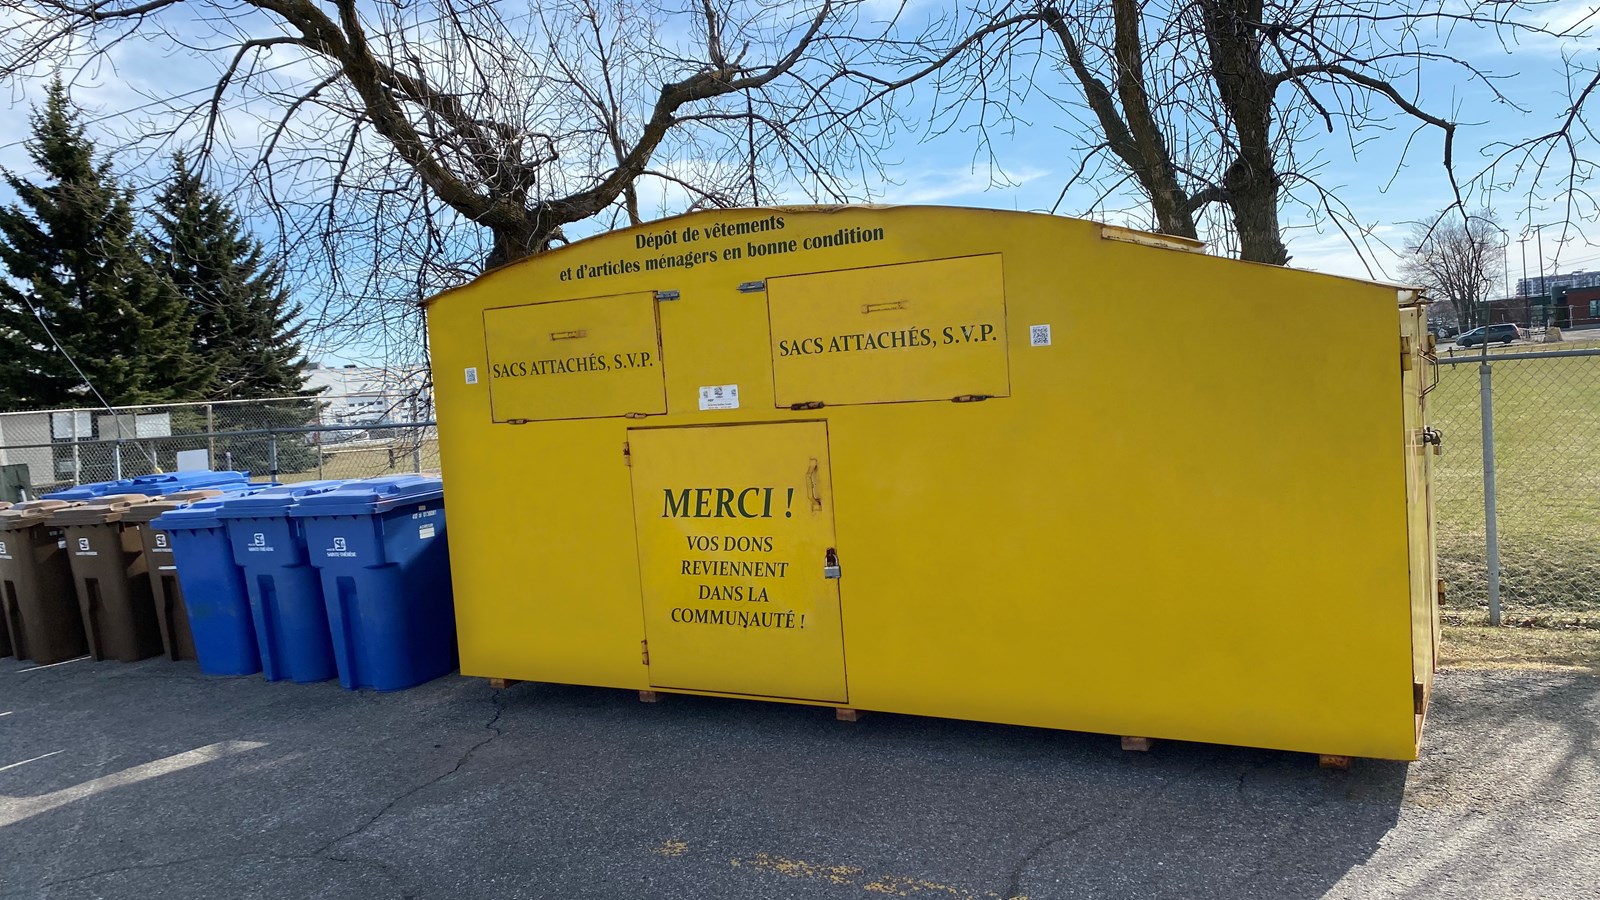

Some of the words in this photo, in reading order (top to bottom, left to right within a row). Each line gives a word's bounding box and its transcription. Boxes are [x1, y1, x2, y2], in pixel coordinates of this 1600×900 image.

[635, 229, 677, 250] Dépôt
[682, 227, 699, 242] de
[704, 214, 785, 239] vêtements
[559, 267, 572, 282] et
[576, 257, 641, 280] d'articles
[645, 250, 718, 271] ménagers
[723, 246, 742, 260] en
[747, 236, 798, 258] bonne
[802, 224, 884, 251] condition
[780, 336, 824, 357] SACS
[828, 326, 938, 353] ATTACHÉS,
[942, 323, 997, 345] S.V.P.
[493, 361, 527, 378] SACS
[530, 353, 611, 376] ATTACHÉS,
[614, 351, 653, 369] S.V.P.
[661, 487, 774, 518] MERCI
[687, 535, 719, 551] VOS
[723, 536, 773, 553] DONS
[681, 560, 788, 577] REVIENNENT
[698, 585, 743, 602] DANS
[748, 586, 769, 602] LA
[671, 607, 795, 629] COMMUNAUTÉ
